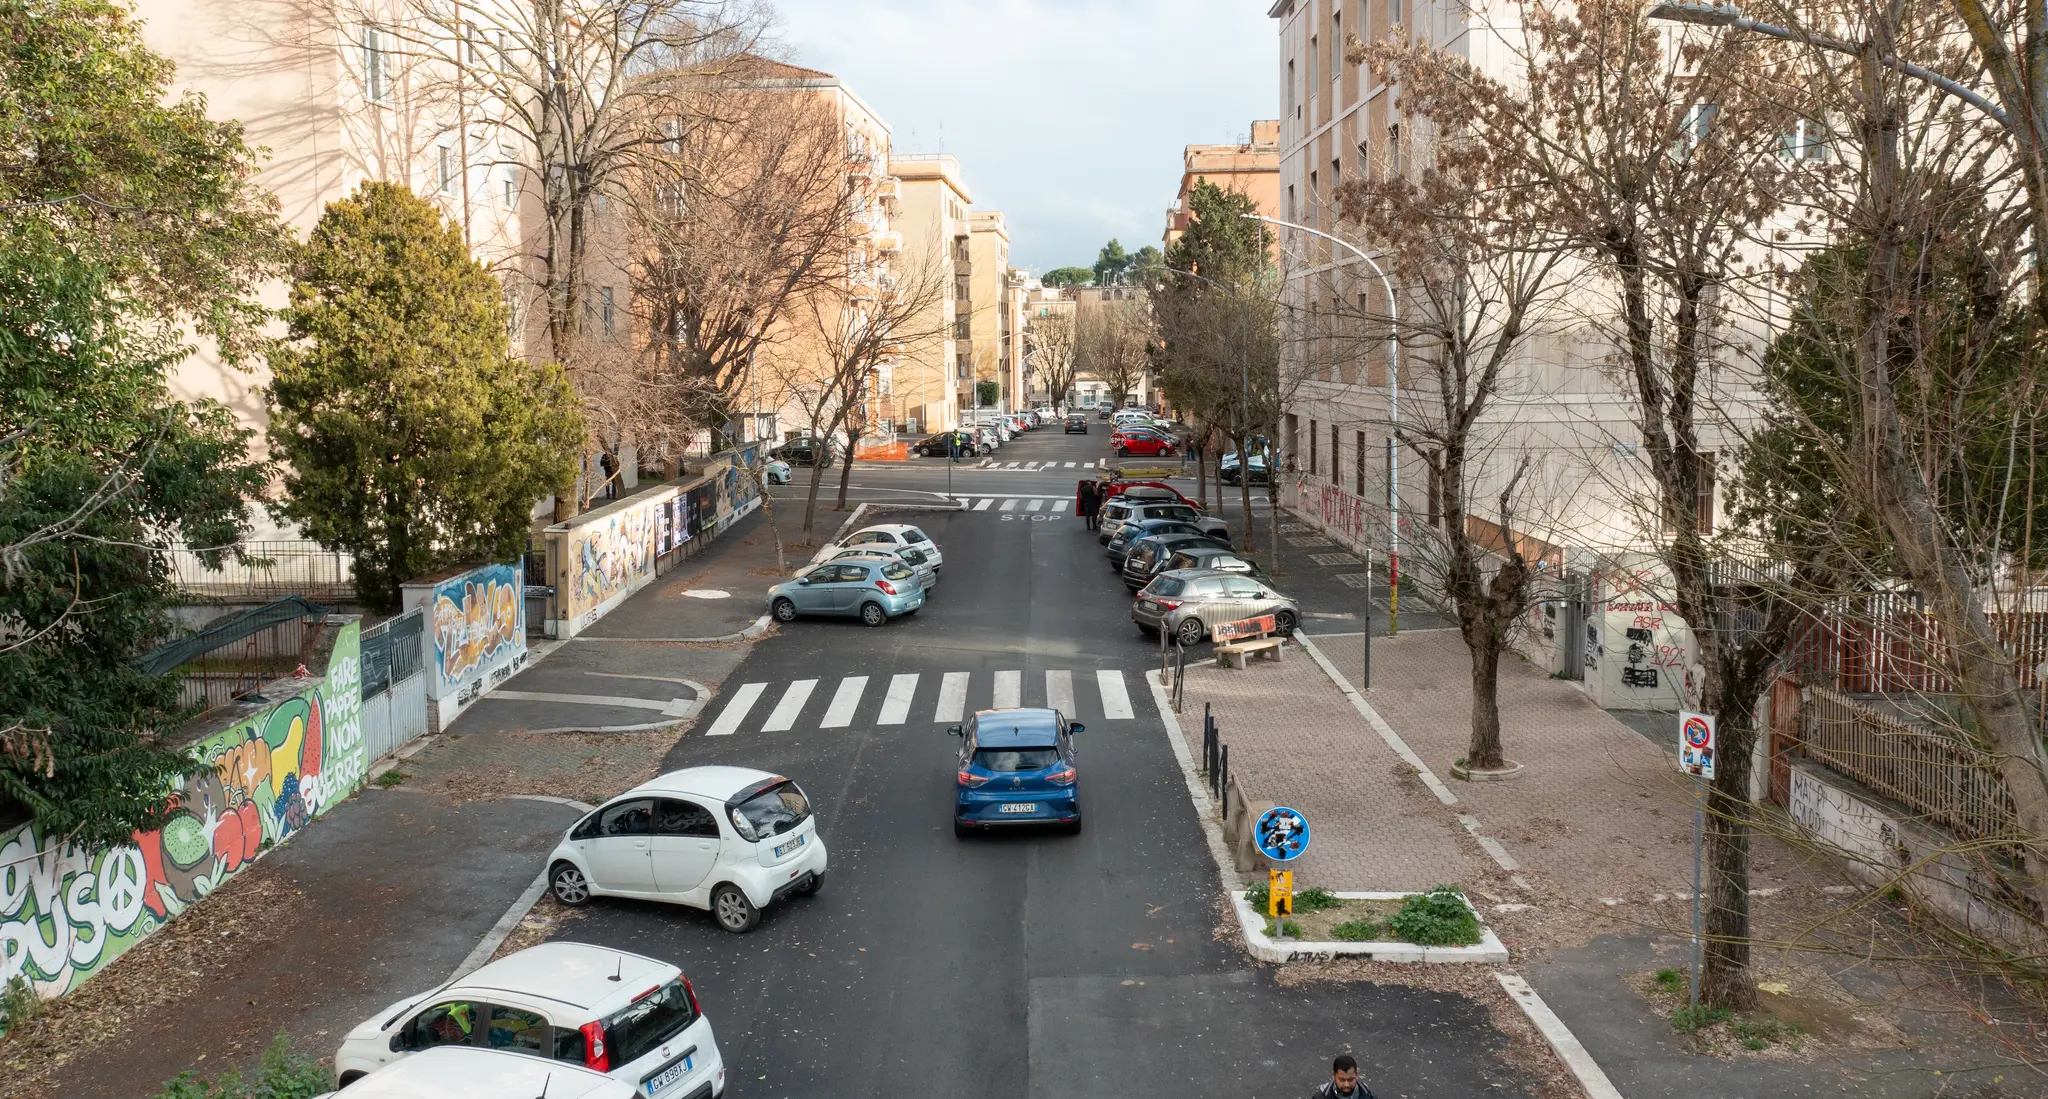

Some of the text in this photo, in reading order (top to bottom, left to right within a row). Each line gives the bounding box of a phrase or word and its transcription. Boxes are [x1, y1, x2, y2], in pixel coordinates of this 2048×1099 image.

[1000, 514, 1061, 522] STOP
[331, 656, 359, 693] FARE
[325, 687, 360, 725] PAPPE
[330, 715, 361, 759] NON
[299, 746, 363, 815] GUERRE
[664, 1061, 687, 1083] 898XJ
